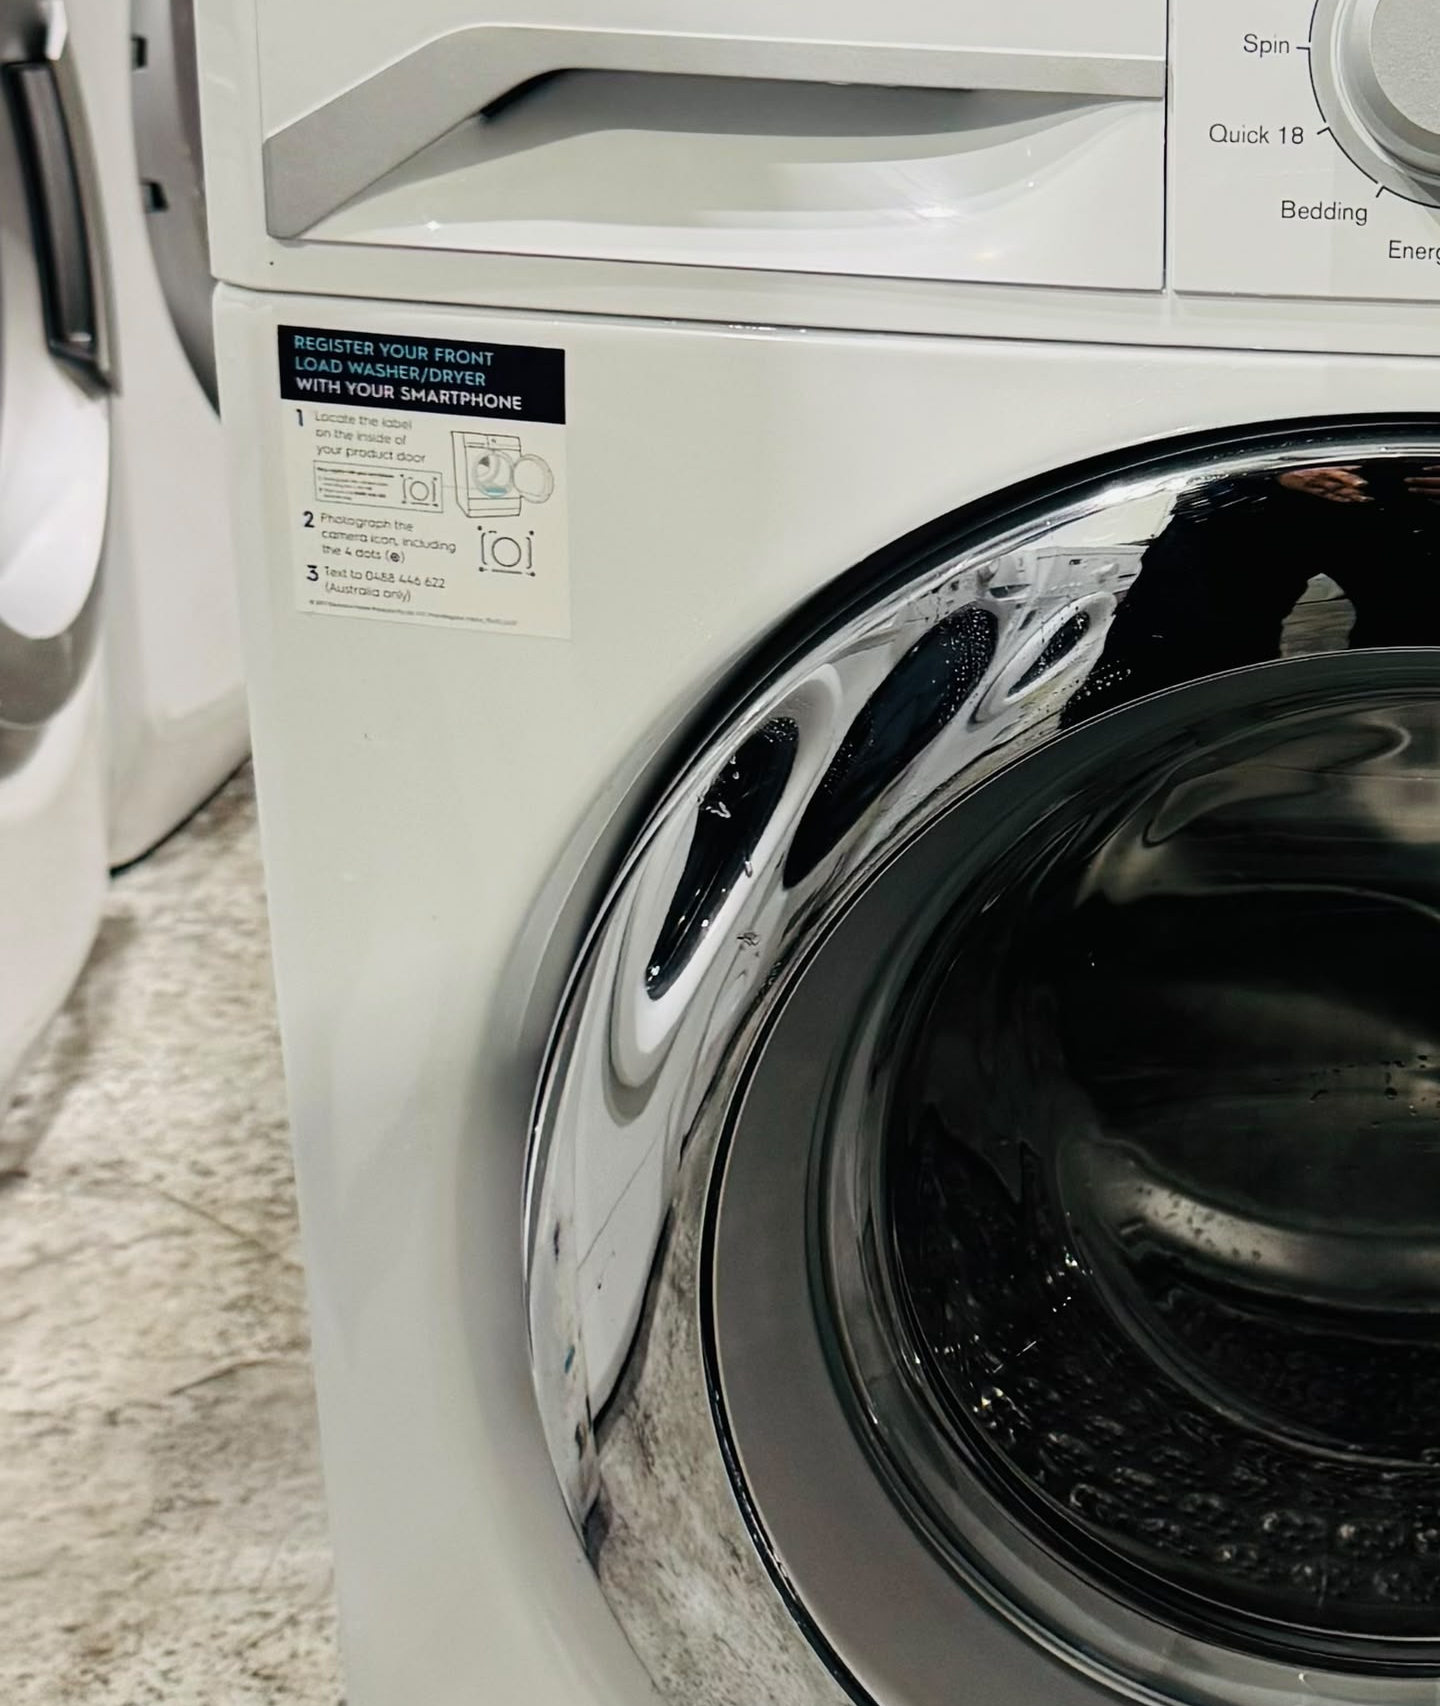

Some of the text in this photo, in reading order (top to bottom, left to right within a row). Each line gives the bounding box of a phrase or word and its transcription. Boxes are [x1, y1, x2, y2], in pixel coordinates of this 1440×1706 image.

[1243, 33, 1290, 59] Spin
[1209, 123, 1304, 145] Quick 18
[1281, 200, 1368, 226] Bedding
[294, 334, 494, 366] REGISTER YOUR FRONT
[295, 356, 486, 386] LOAD WASHER/DRYER
[296, 376, 522, 410] WITH YOUR SMARTPHONE
[296, 408, 304, 427] 1
[303, 510, 315, 529] 2
[306, 564, 319, 582] 3
